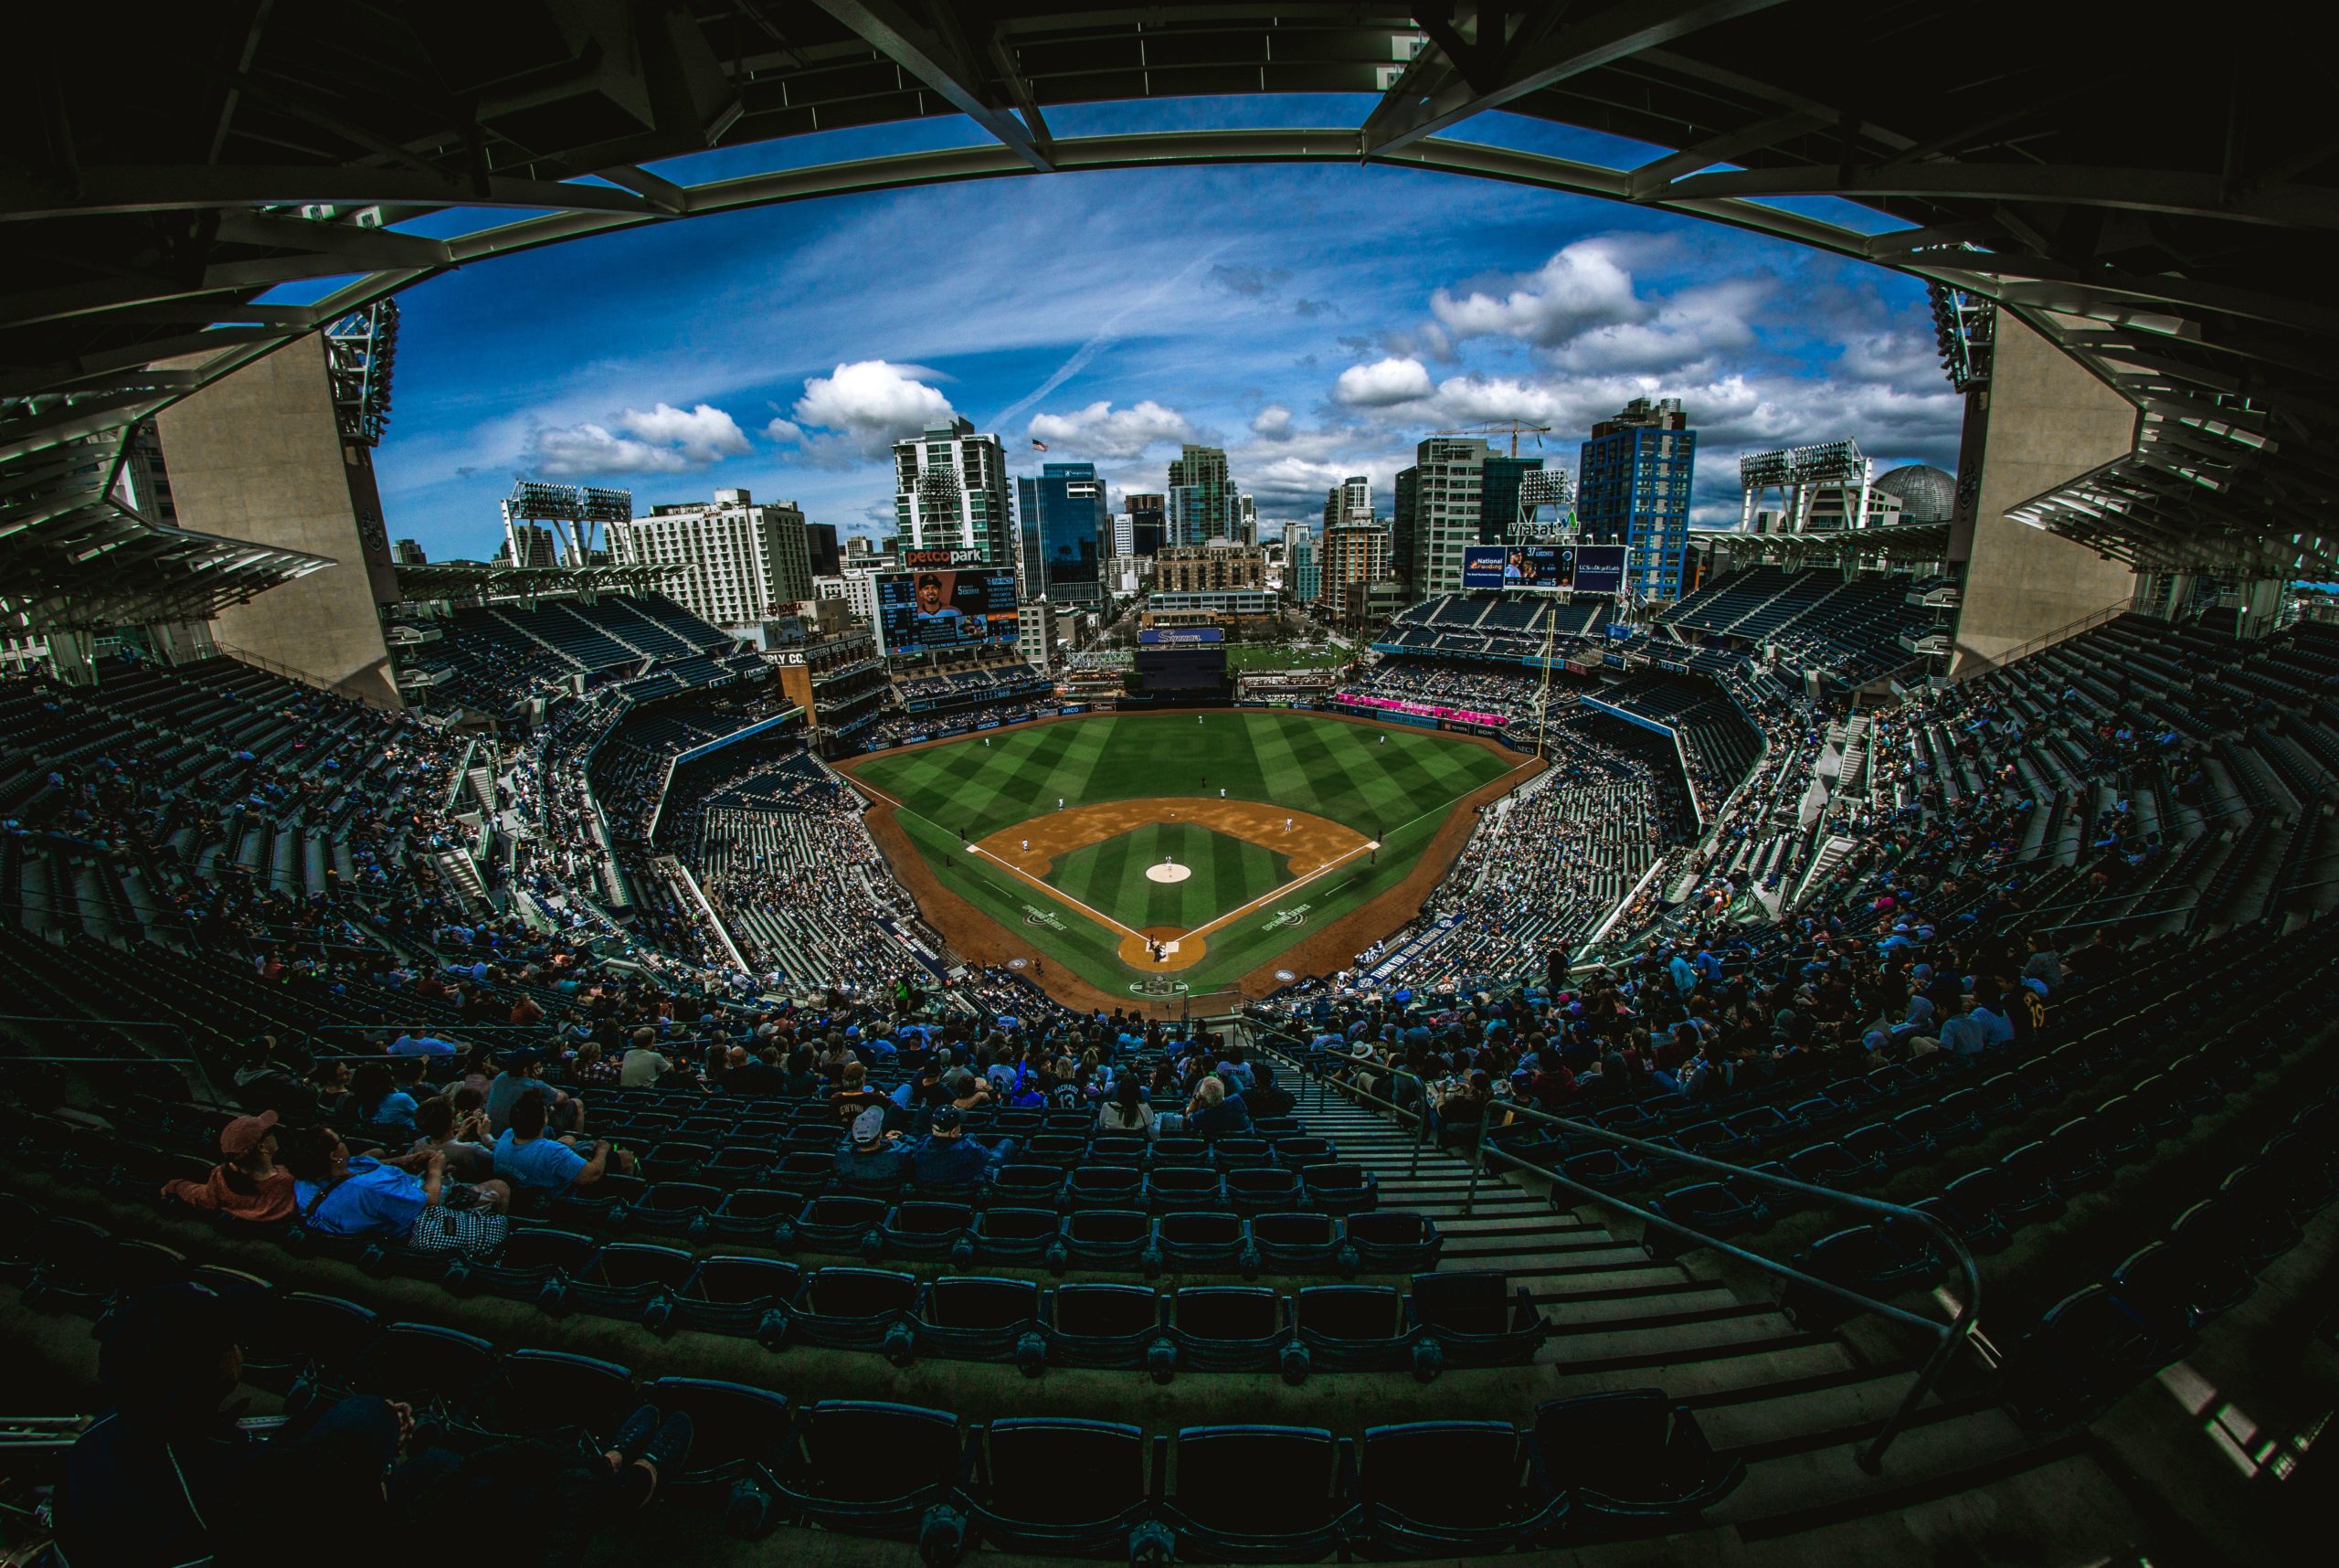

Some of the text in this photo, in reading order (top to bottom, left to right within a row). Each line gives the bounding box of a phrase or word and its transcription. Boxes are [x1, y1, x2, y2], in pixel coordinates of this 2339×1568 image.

[1509, 523, 1556, 535] Viasat
[1527, 546, 1537, 556] 37
[958, 585, 962, 595] 5
[778, 602, 803, 612] TOYOTA
[806, 647, 831, 660] WESTERN
[831, 643, 846, 653] METAL
[848, 638, 863, 650] SUPPLY
[788, 652, 807, 664] CO.
[1063, 706, 1079, 715] ARCO
[977, 721, 999, 730] GEICO
[938, 727, 967, 737] Qualcomm
[1517, 745, 1534, 754] NECA
[1043, 917, 1067, 930] SERIES
[1262, 904, 1312, 931] OPENING SERIES
[891, 922, 912, 937] WELCOME
[1371, 962, 1398, 979] THANK
[1388, 954, 1407, 967] YOU
[1401, 943, 1423, 957] FRIAR
[1053, 1084, 1079, 1096] MACHADO
[1058, 1094, 1075, 1110] 13
